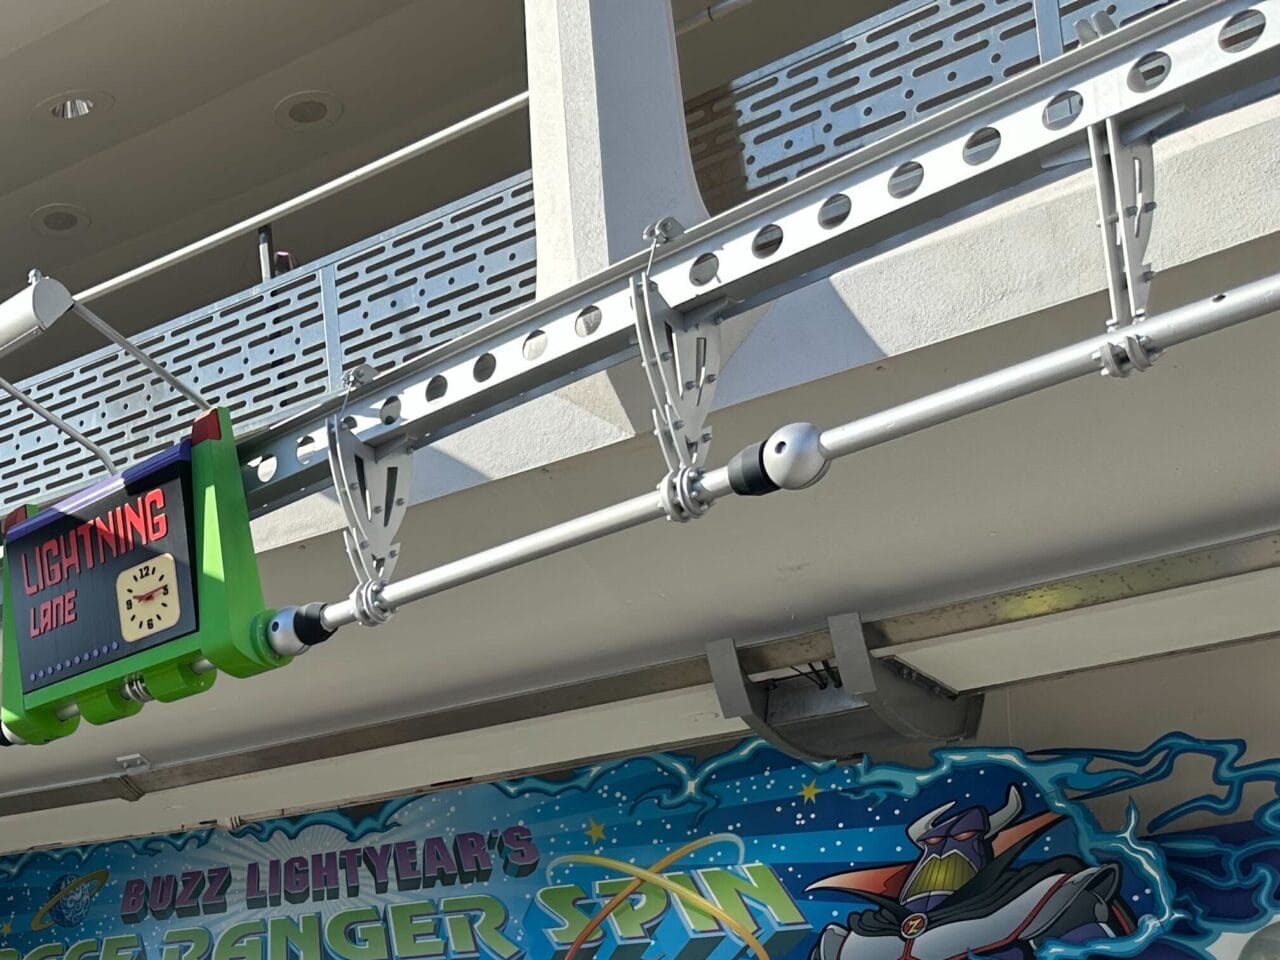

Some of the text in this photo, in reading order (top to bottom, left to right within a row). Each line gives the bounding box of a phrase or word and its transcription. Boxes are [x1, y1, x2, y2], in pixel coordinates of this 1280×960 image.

[21, 487, 167, 597] LIGHTNING
[140, 566, 150, 579] 12
[30, 590, 78, 639] LANE
[147, 618, 154, 630] 6
[121, 823, 542, 926] BUZZ LIGHTYEAR'S
